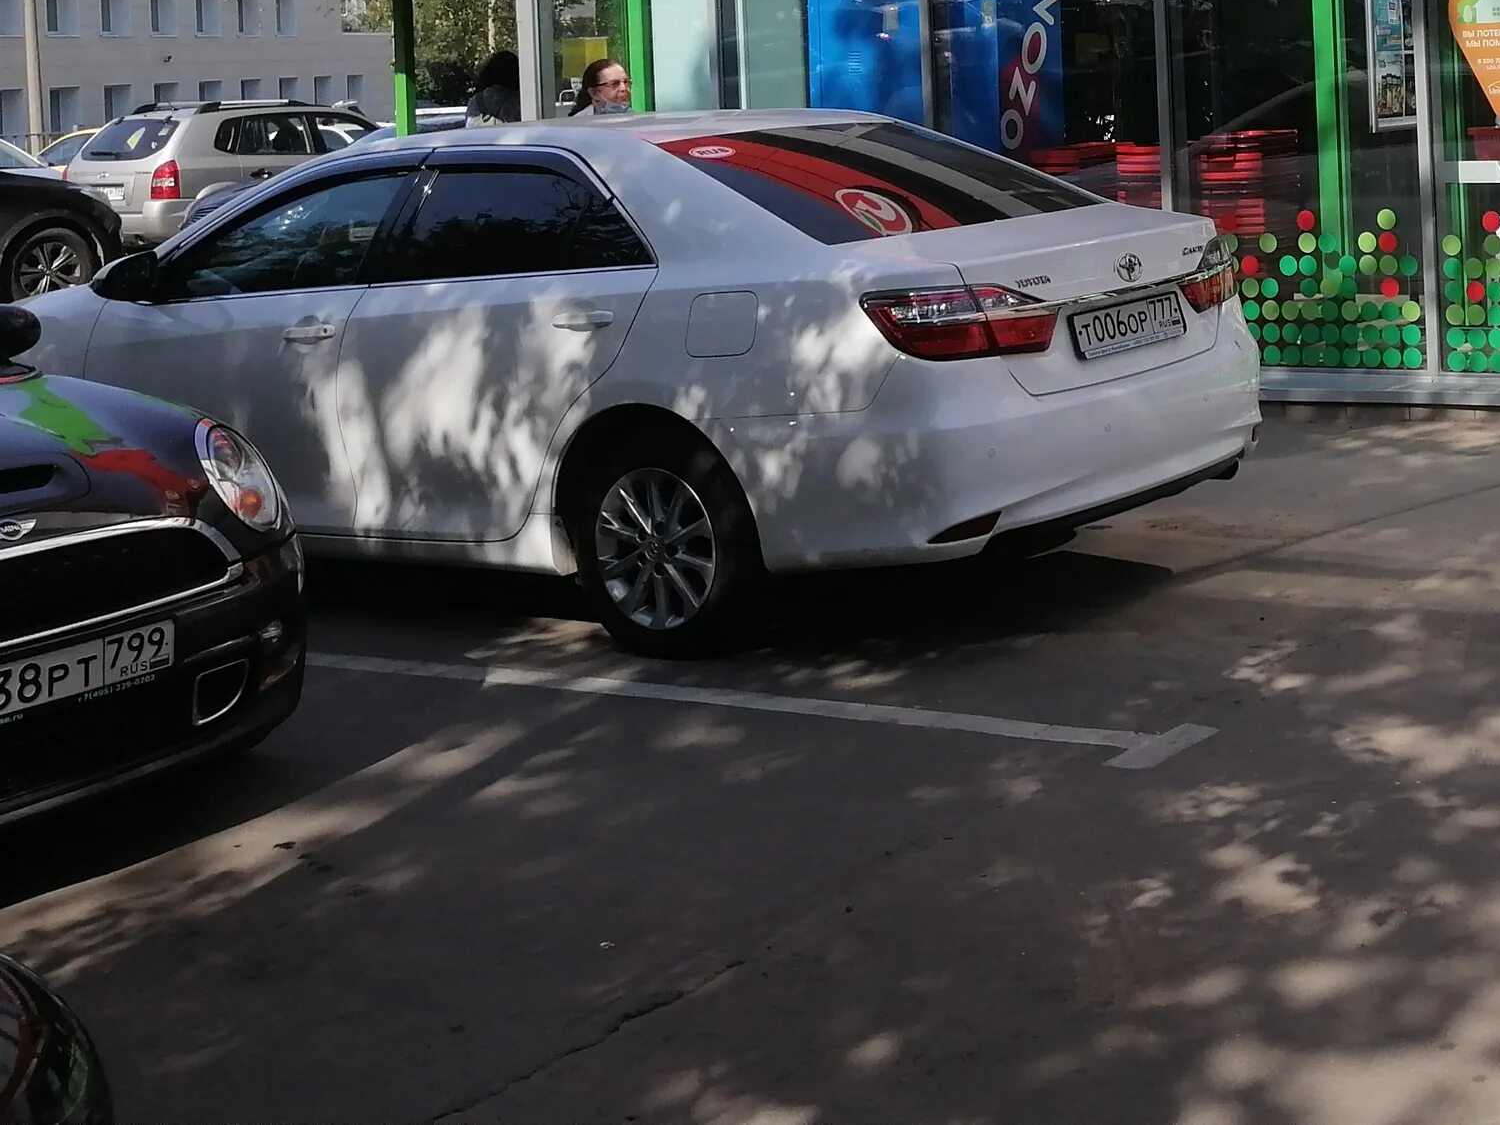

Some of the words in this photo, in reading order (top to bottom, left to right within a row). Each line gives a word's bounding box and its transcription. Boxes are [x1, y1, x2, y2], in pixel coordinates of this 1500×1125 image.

[1462, 30, 1475, 38] ВЫ
[1466, 40, 1481, 48] МЫ
[1148, 296, 1173, 321] 777
[1159, 318, 1172, 329] RUS
[106, 626, 165, 670] 799
[120, 660, 149, 677] RUS
